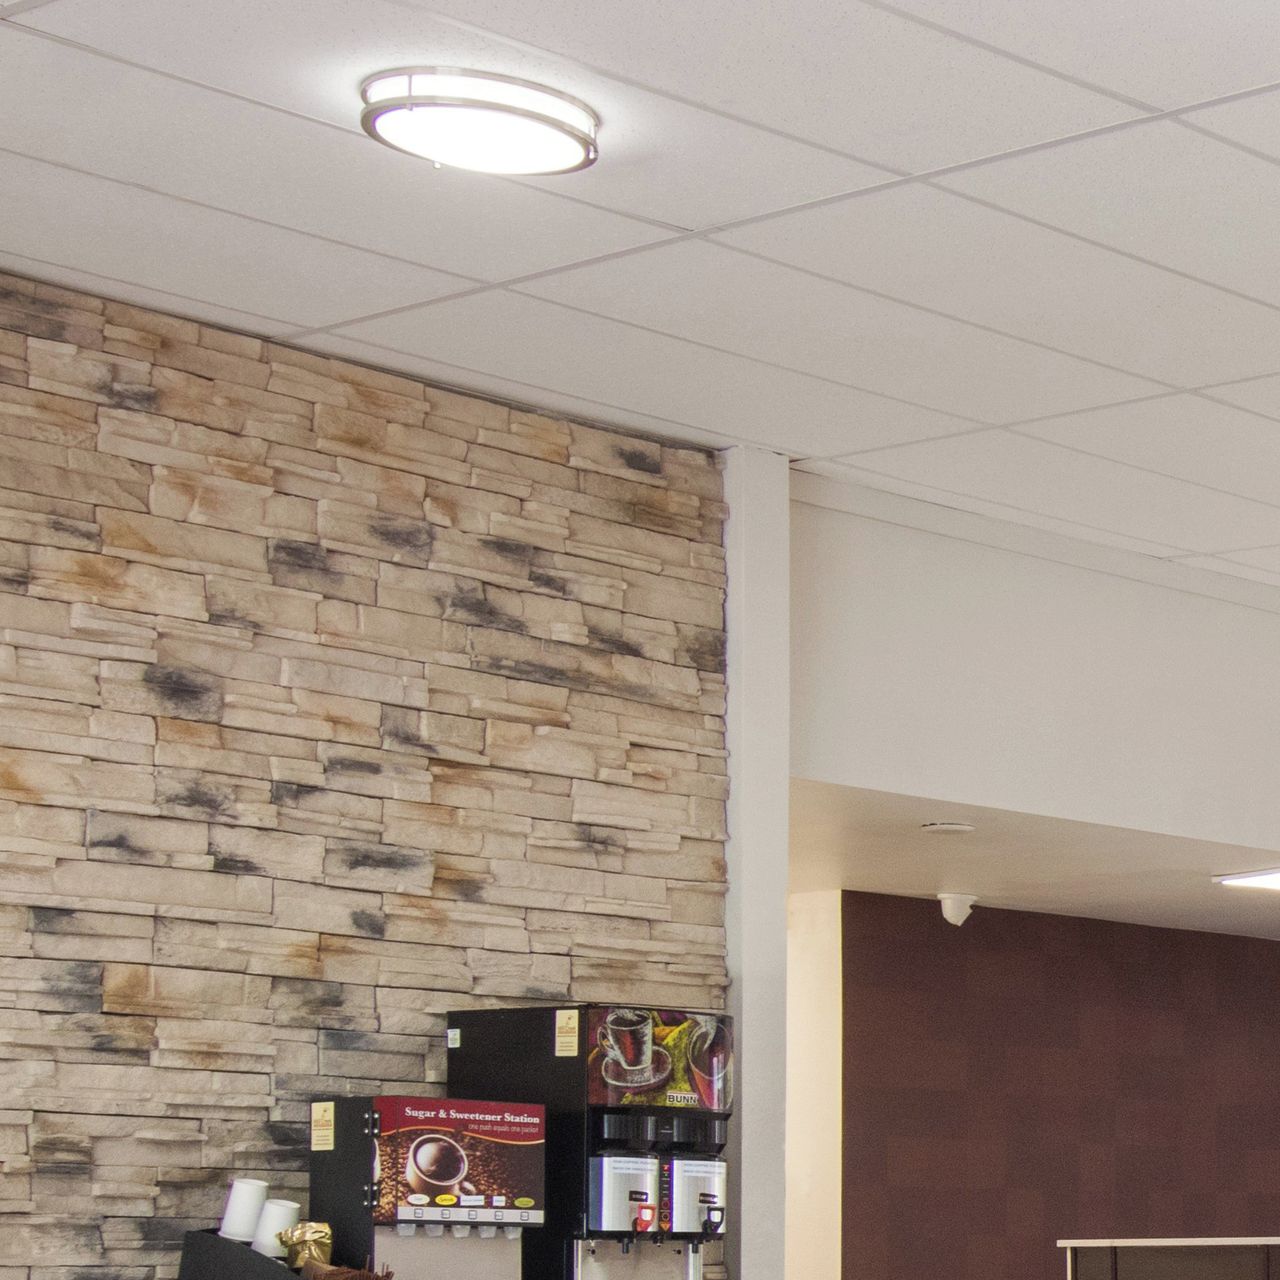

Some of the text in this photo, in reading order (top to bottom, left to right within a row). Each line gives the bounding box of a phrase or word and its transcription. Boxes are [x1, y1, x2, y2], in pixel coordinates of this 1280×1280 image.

[668, 1094, 697, 1104] BUNN
[405, 1106, 540, 1124] Sugar & Sweetener Station
